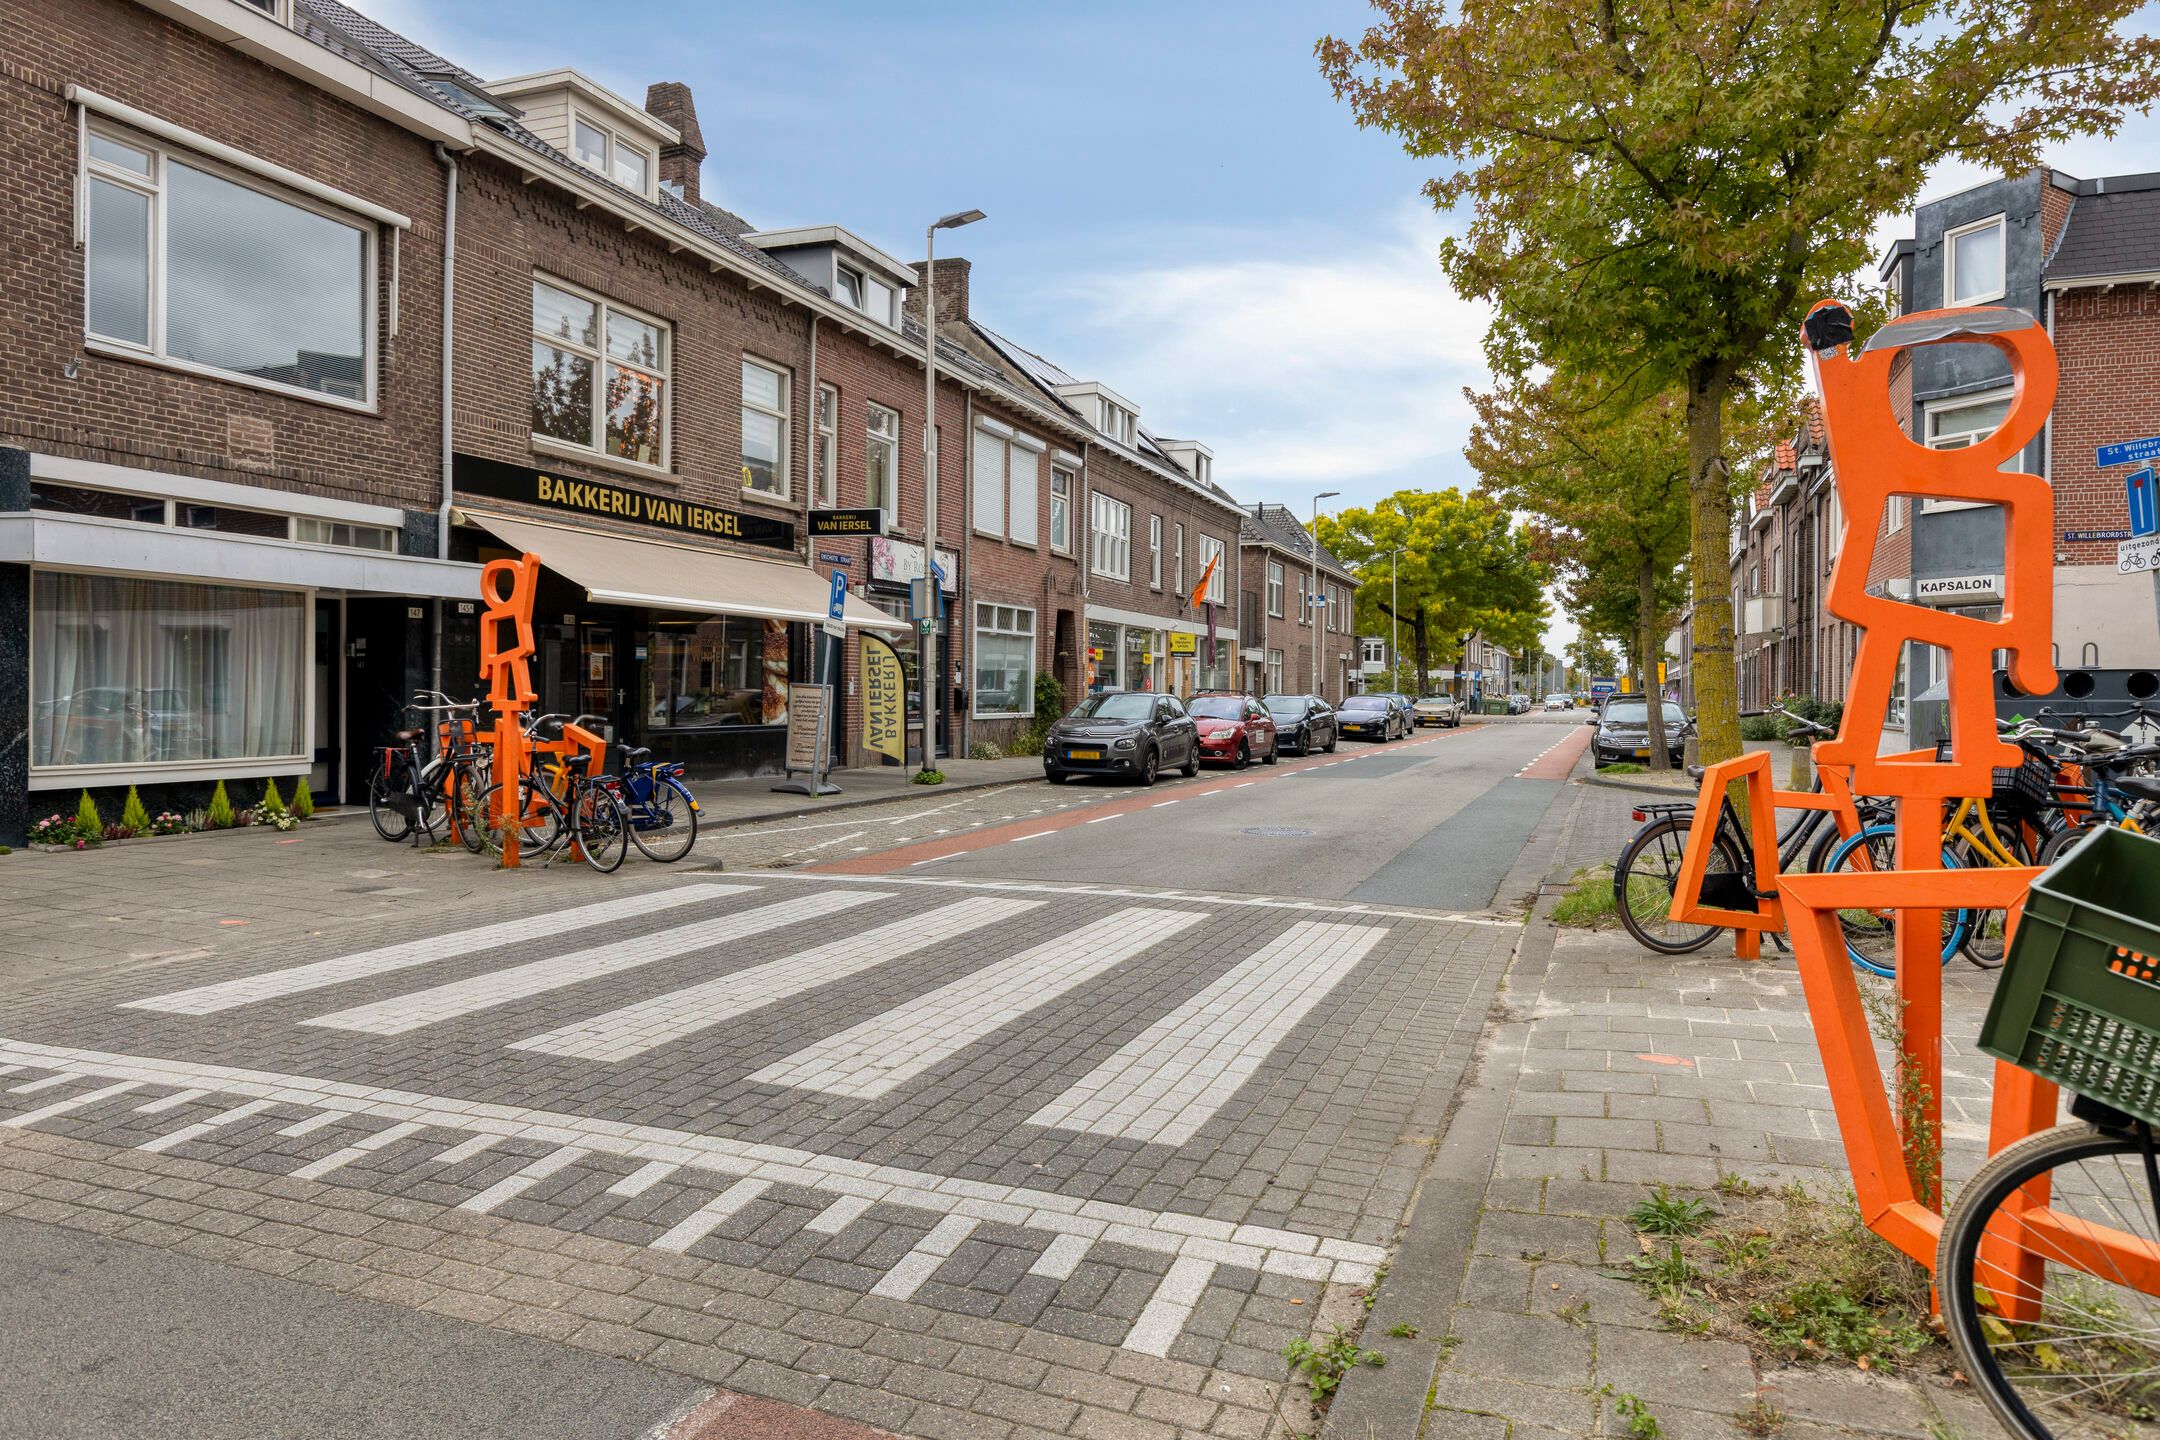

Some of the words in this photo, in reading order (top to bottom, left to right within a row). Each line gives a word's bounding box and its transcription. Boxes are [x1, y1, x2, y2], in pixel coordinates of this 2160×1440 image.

[2107, 447, 2122, 455] St.
[2124, 440, 2160, 452] Willebr
[538, 475, 640, 517] BAKKERIJ
[645, 497, 683, 526] VAN
[687, 506, 743, 537] IERSEL
[817, 521, 838, 531] VAN
[839, 520, 872, 531] IERSEL
[2078, 531, 2132, 540] WILLEBRORDSTR
[2120, 538, 2160, 553] uitgezond
[903, 558, 912, 572] BY
[1920, 579, 1992, 593] KAPSALON
[409, 608, 421, 618] 147
